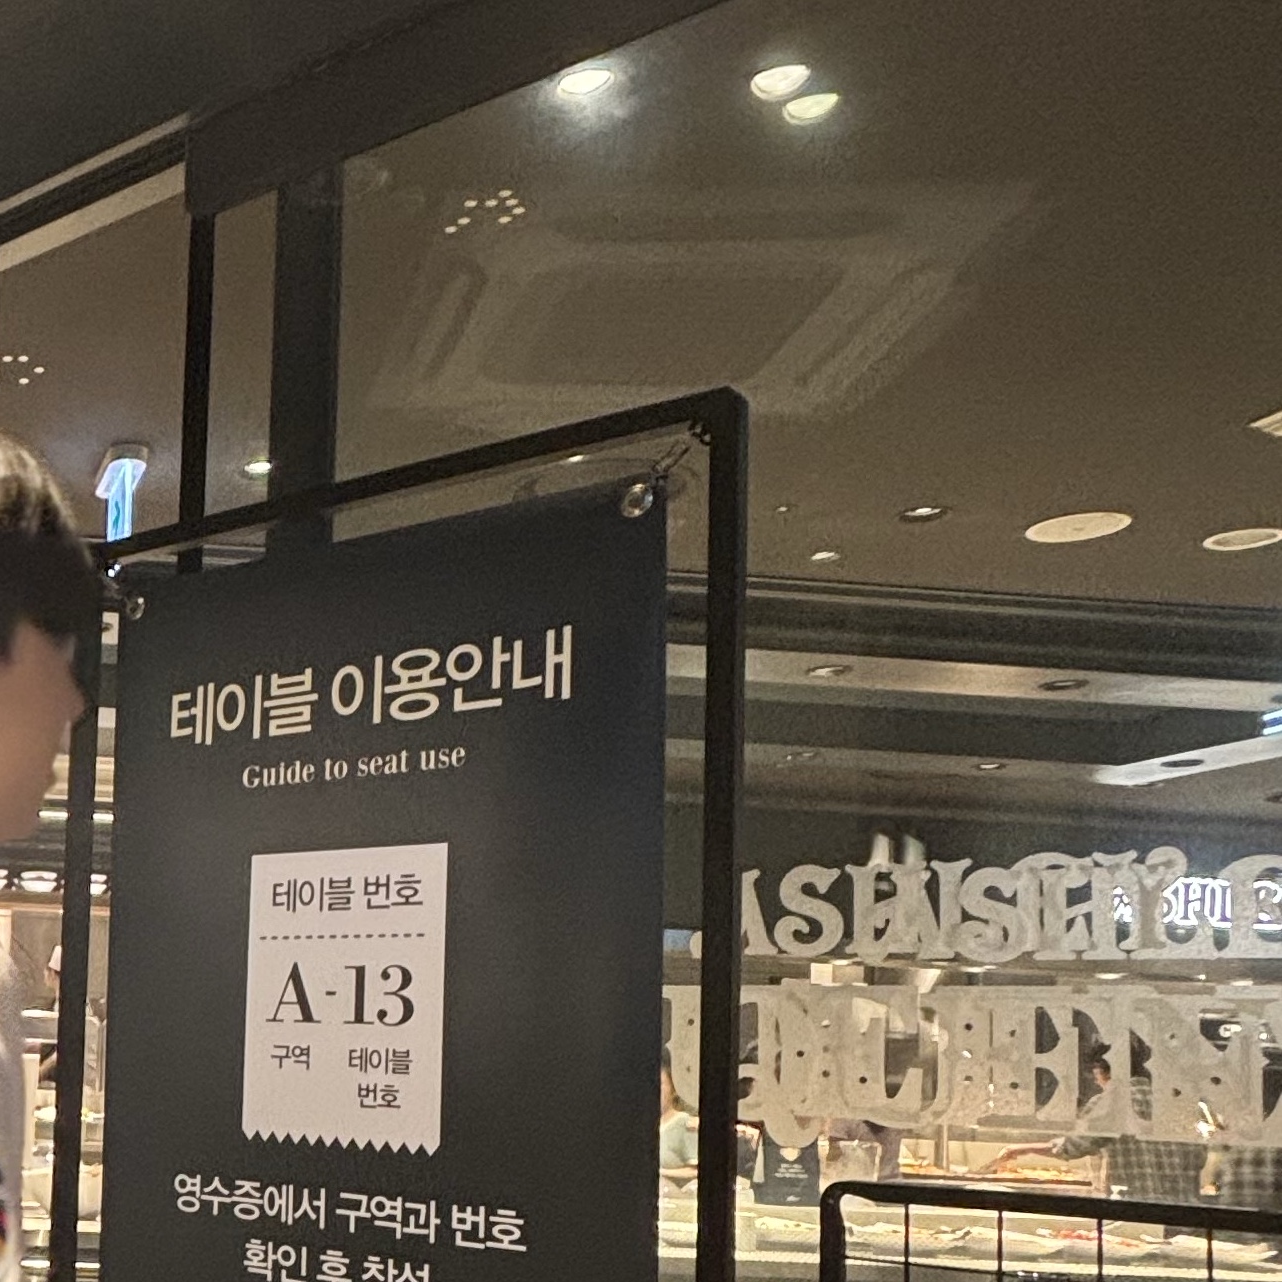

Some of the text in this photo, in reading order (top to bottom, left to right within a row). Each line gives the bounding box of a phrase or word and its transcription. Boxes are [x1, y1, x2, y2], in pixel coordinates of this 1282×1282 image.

[170, 625, 573, 746] 테이블 이용안내
[242, 746, 466, 789] Guide to seat use
[272, 873, 423, 913] 테이블 번호
[270, 1044, 311, 1071] 구역
[348, 1047, 413, 1075] 테이블
[357, 1084, 401, 1109] 번호
[174, 1173, 527, 1252] 영수증에서 구역과 번호
